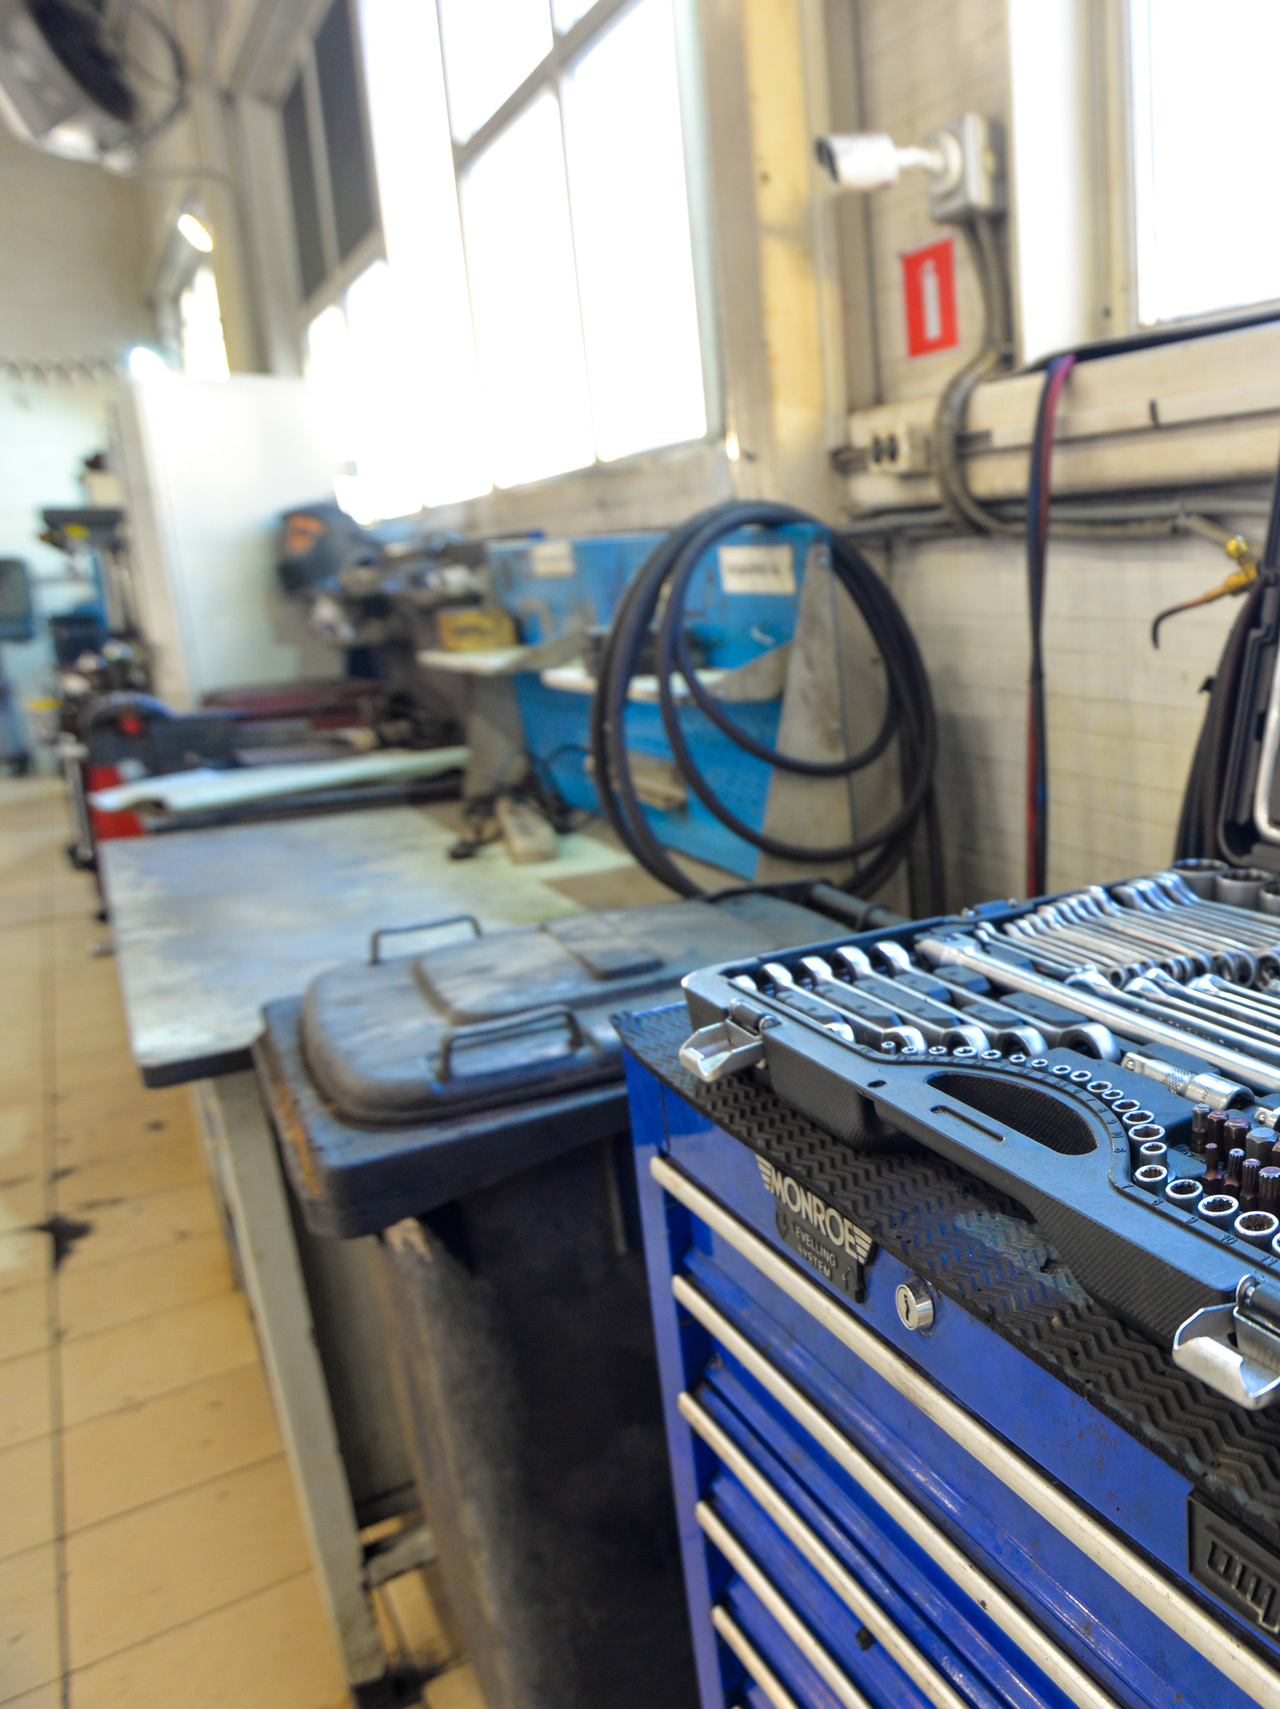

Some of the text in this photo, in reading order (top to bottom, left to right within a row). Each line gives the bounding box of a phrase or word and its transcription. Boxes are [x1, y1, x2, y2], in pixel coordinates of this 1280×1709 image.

[771, 1165, 857, 1260] MONROE
[1185, 1216, 1199, 1225] 9
[1220, 1234, 1238, 1245] 10
[798, 1244, 831, 1278] SYSTEM
[1260, 1255, 1278, 1267] 11
